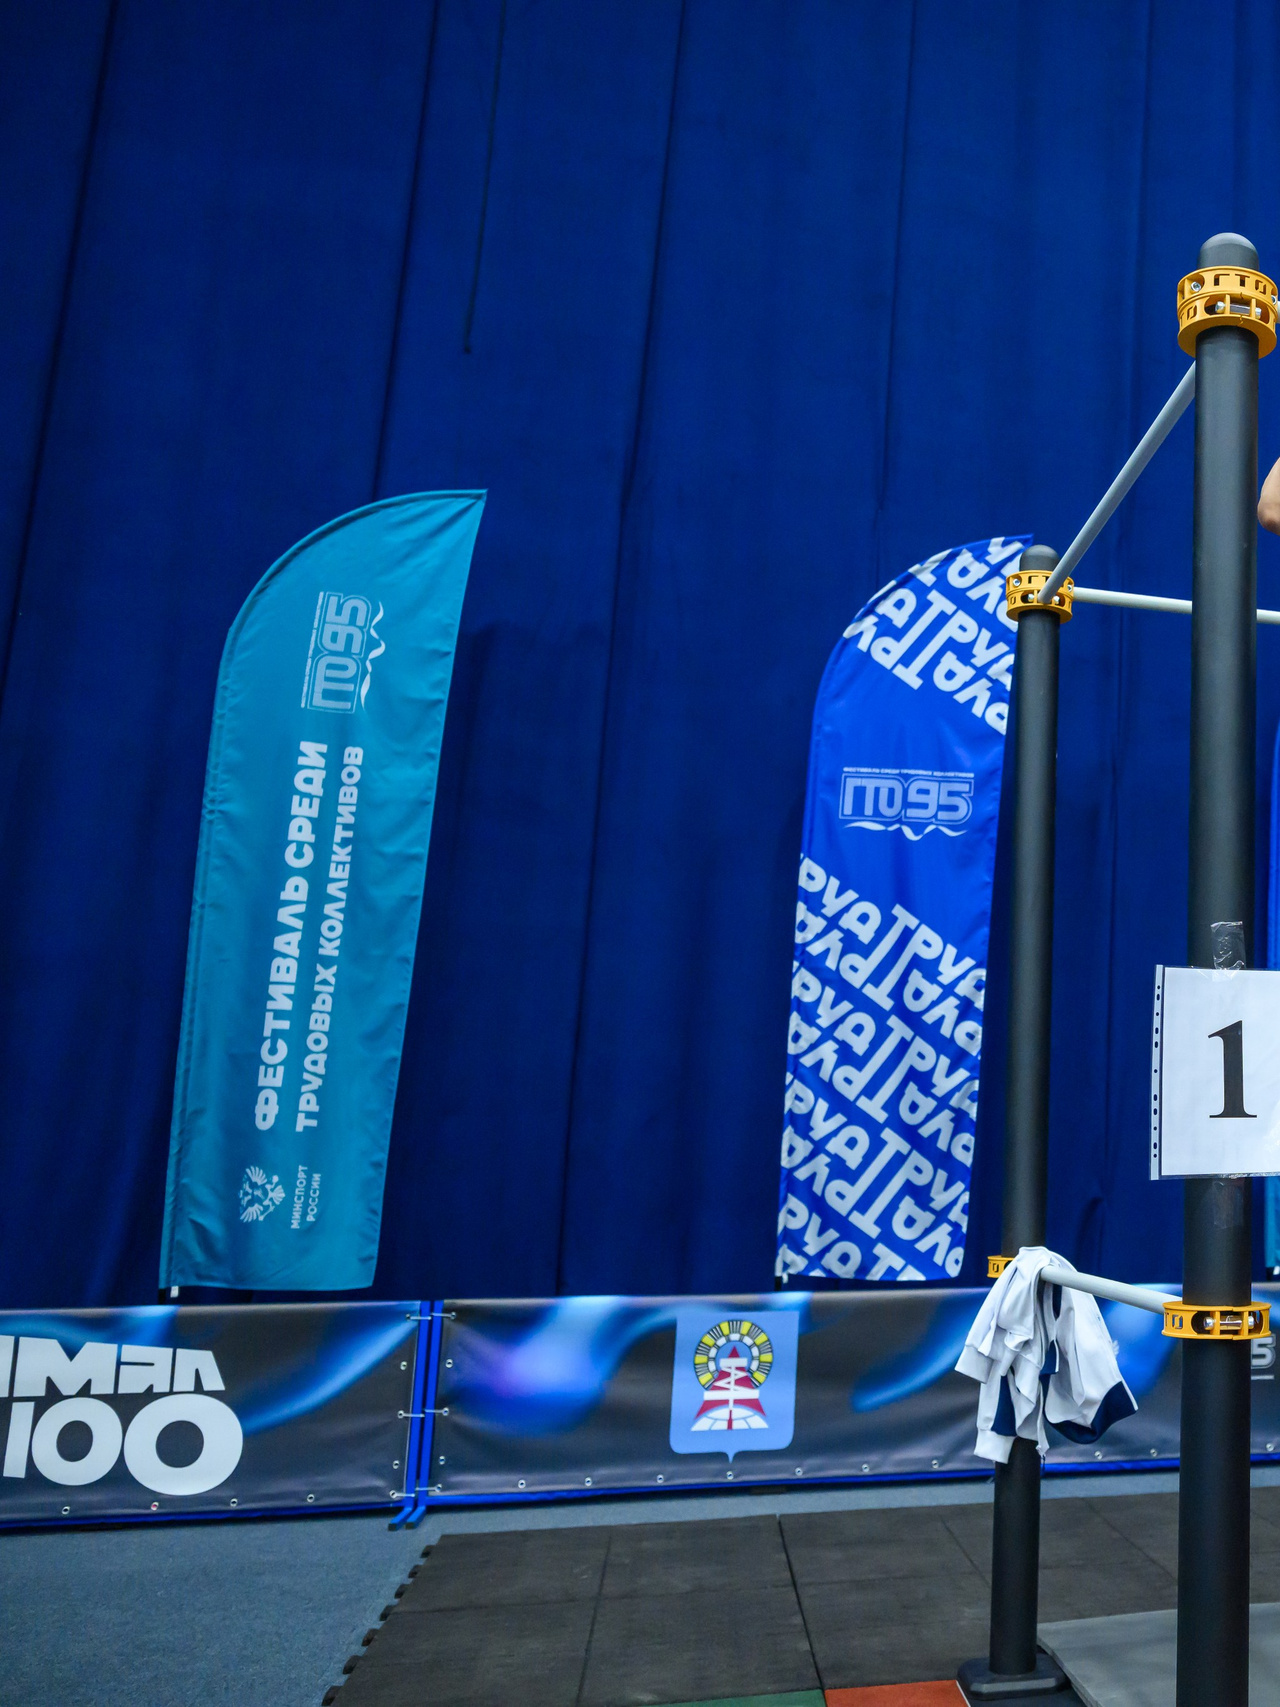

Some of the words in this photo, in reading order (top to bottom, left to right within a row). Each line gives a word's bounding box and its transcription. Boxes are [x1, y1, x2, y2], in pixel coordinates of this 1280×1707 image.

[933, 651, 1010, 736] РУД
[254, 876, 310, 1132] ФЕСТИВАЛЬ
[284, 741, 328, 870] СРЕДИ
[295, 961, 339, 1132] ТРУДОВЫХ
[319, 745, 364, 957] КОЛЛЕКТИВОВ
[798, 854, 882, 945] РУД
[792, 960, 877, 1056] РУД
[903, 969, 984, 1060] РУД
[1208, 1020, 1258, 1118] 1
[784, 1072, 870, 1171] РУД
[898, 1080, 977, 1168] РУД
[290, 1164, 308, 1230] МИНСПОРТ
[306, 1173, 323, 1222] РОССИИ
[777, 1193, 863, 1278] РУД
[891, 1195, 965, 1279] РУД
[3, 1394, 244, 1496] 100
